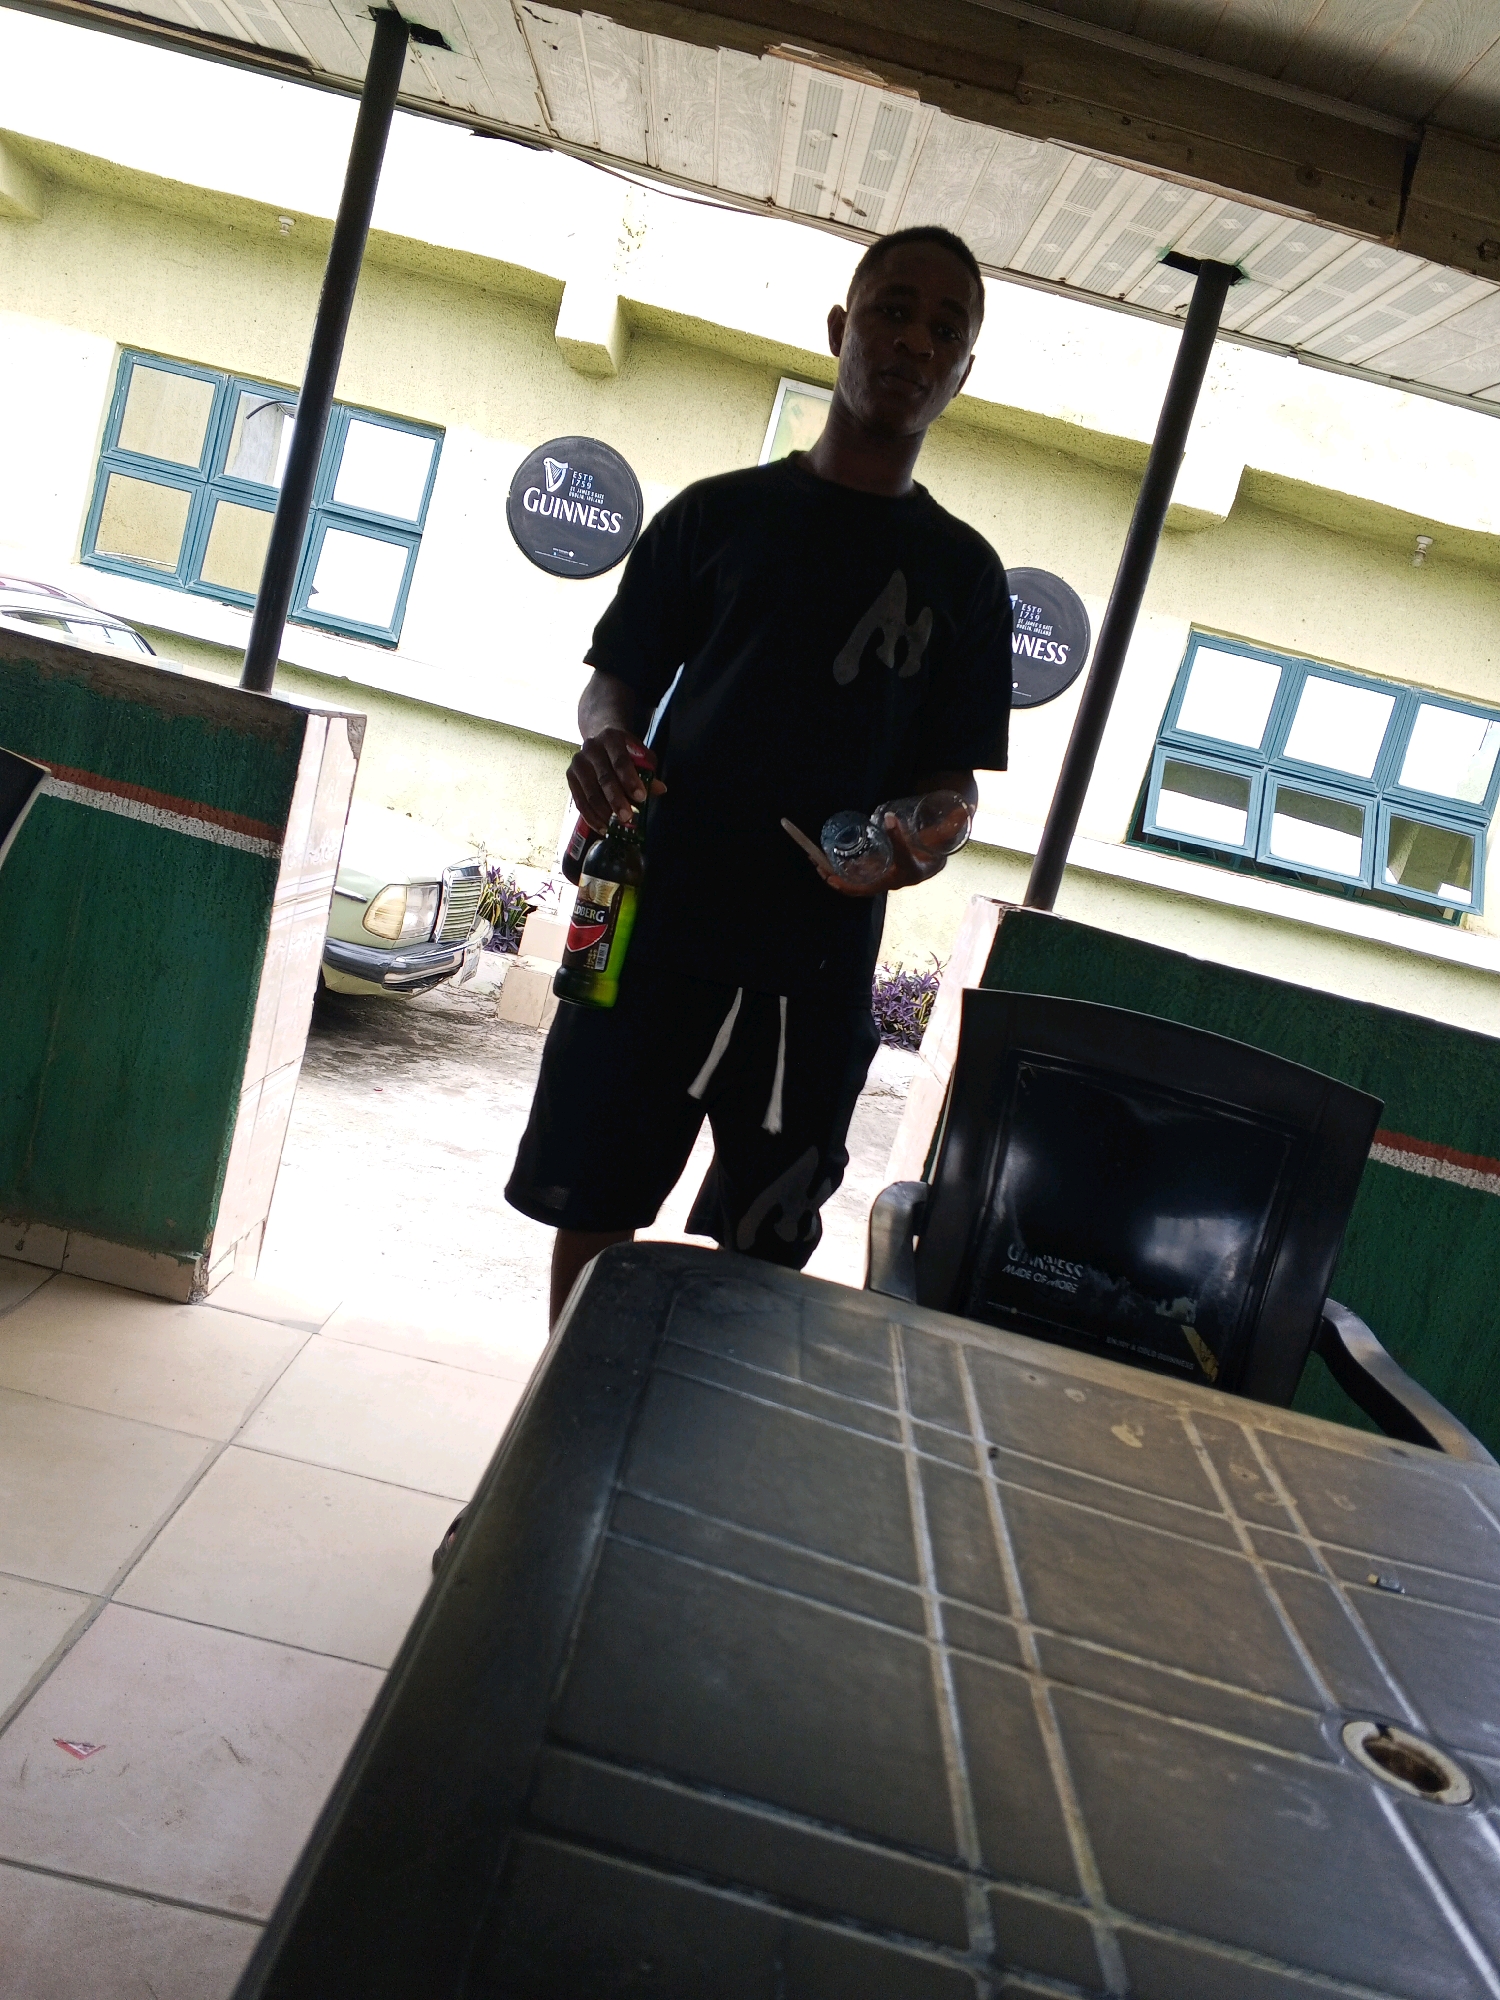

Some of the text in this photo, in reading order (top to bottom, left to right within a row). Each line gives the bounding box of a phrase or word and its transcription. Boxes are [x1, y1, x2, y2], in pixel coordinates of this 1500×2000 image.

[571, 479, 592, 490] 1759
[523, 487, 622, 533] GUINNESS
[1021, 603, 1042, 614] ESTD
[1019, 611, 1040, 621] 1759
[1001, 1264, 1080, 1294] MADE OF MORE
